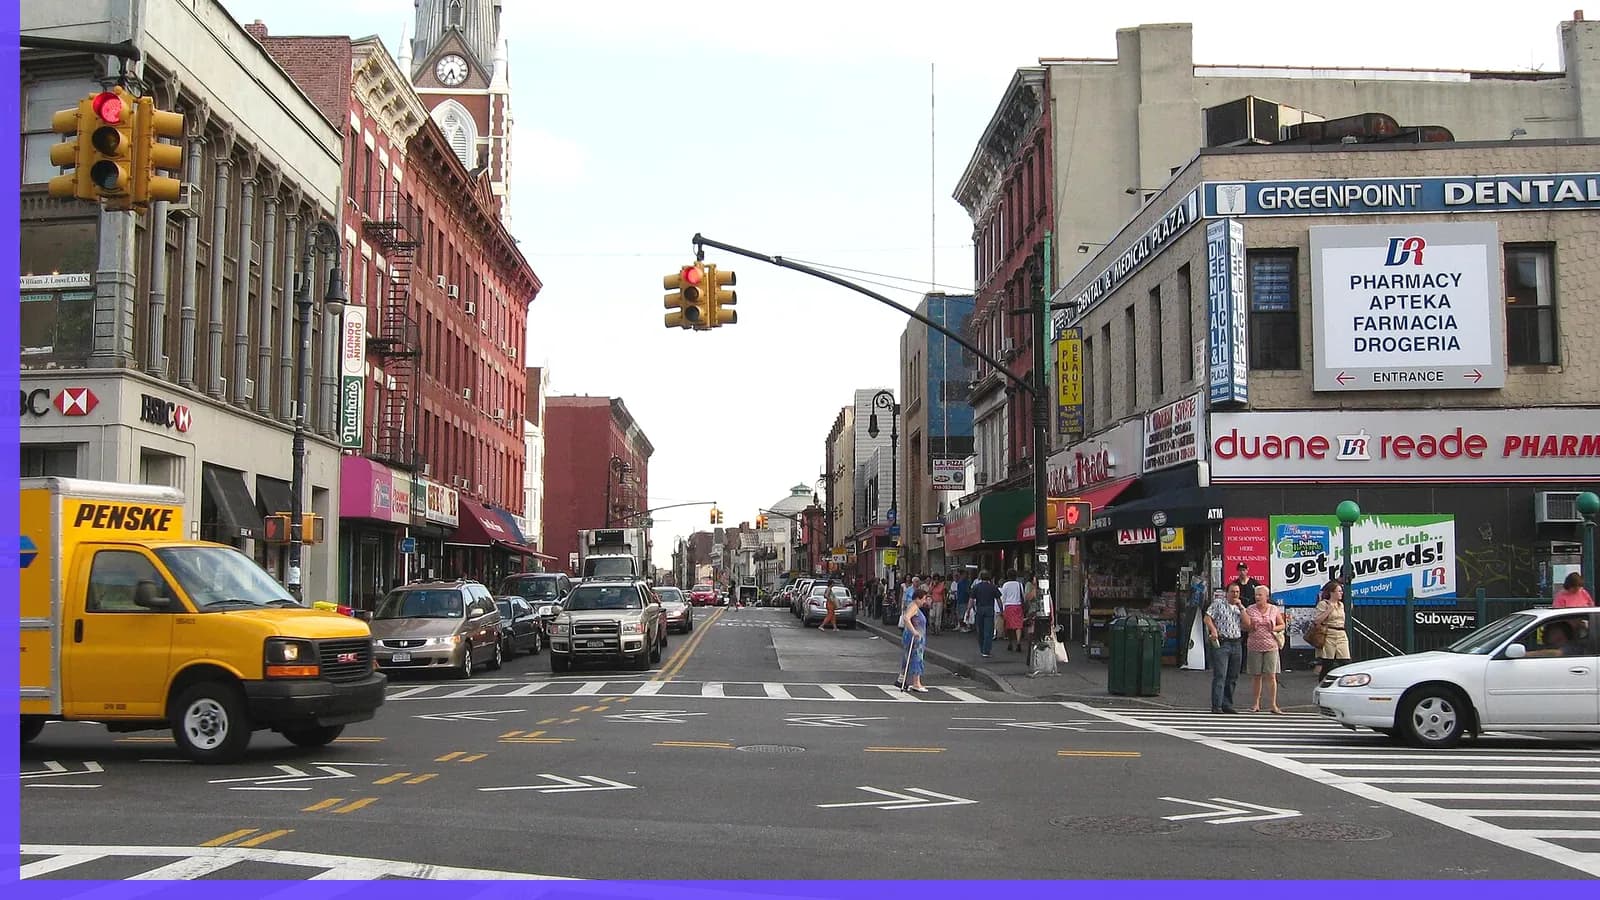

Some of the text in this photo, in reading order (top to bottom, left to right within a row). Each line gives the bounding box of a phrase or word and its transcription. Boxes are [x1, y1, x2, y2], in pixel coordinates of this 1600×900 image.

[1258, 179, 1600, 209] GREENPOINT DENTAL
[1077, 205, 1186, 313] DENTAL & MEDICAL PLAZA
[1384, 236, 1426, 267] DR
[1350, 273, 1462, 290] PHARMACY
[1208, 242, 1219, 365] DENTAL &
[1217, 239, 1228, 363] MEDICAL
[1369, 294, 1452, 310] APTEKA
[1061, 329, 1078, 340] SPA
[1354, 315, 1458, 331] FARMACIA
[346, 321, 355, 359] DONUTS
[354, 322, 363, 361] DUNKIN'
[1354, 336, 1461, 352] DROGERIA
[1071, 343, 1079, 402] BEAUTY
[1373, 371, 1444, 383] ENTRANCE
[20, 388, 50, 417] C
[140, 393, 175, 428] HSBC
[1215, 428, 1330, 460] duane
[1342, 439, 1366, 456] DR
[1380, 427, 1488, 460] reade
[1502, 435, 1600, 458] PHARM
[74, 503, 173, 532] PENSKE
[1208, 508, 1223, 519] ATM
[1368, 539, 1393, 551] the
[1397, 531, 1442, 546] club...
[1285, 552, 1328, 583] get
[1371, 582, 1393, 592] today!
[1415, 612, 1467, 627] Subway
